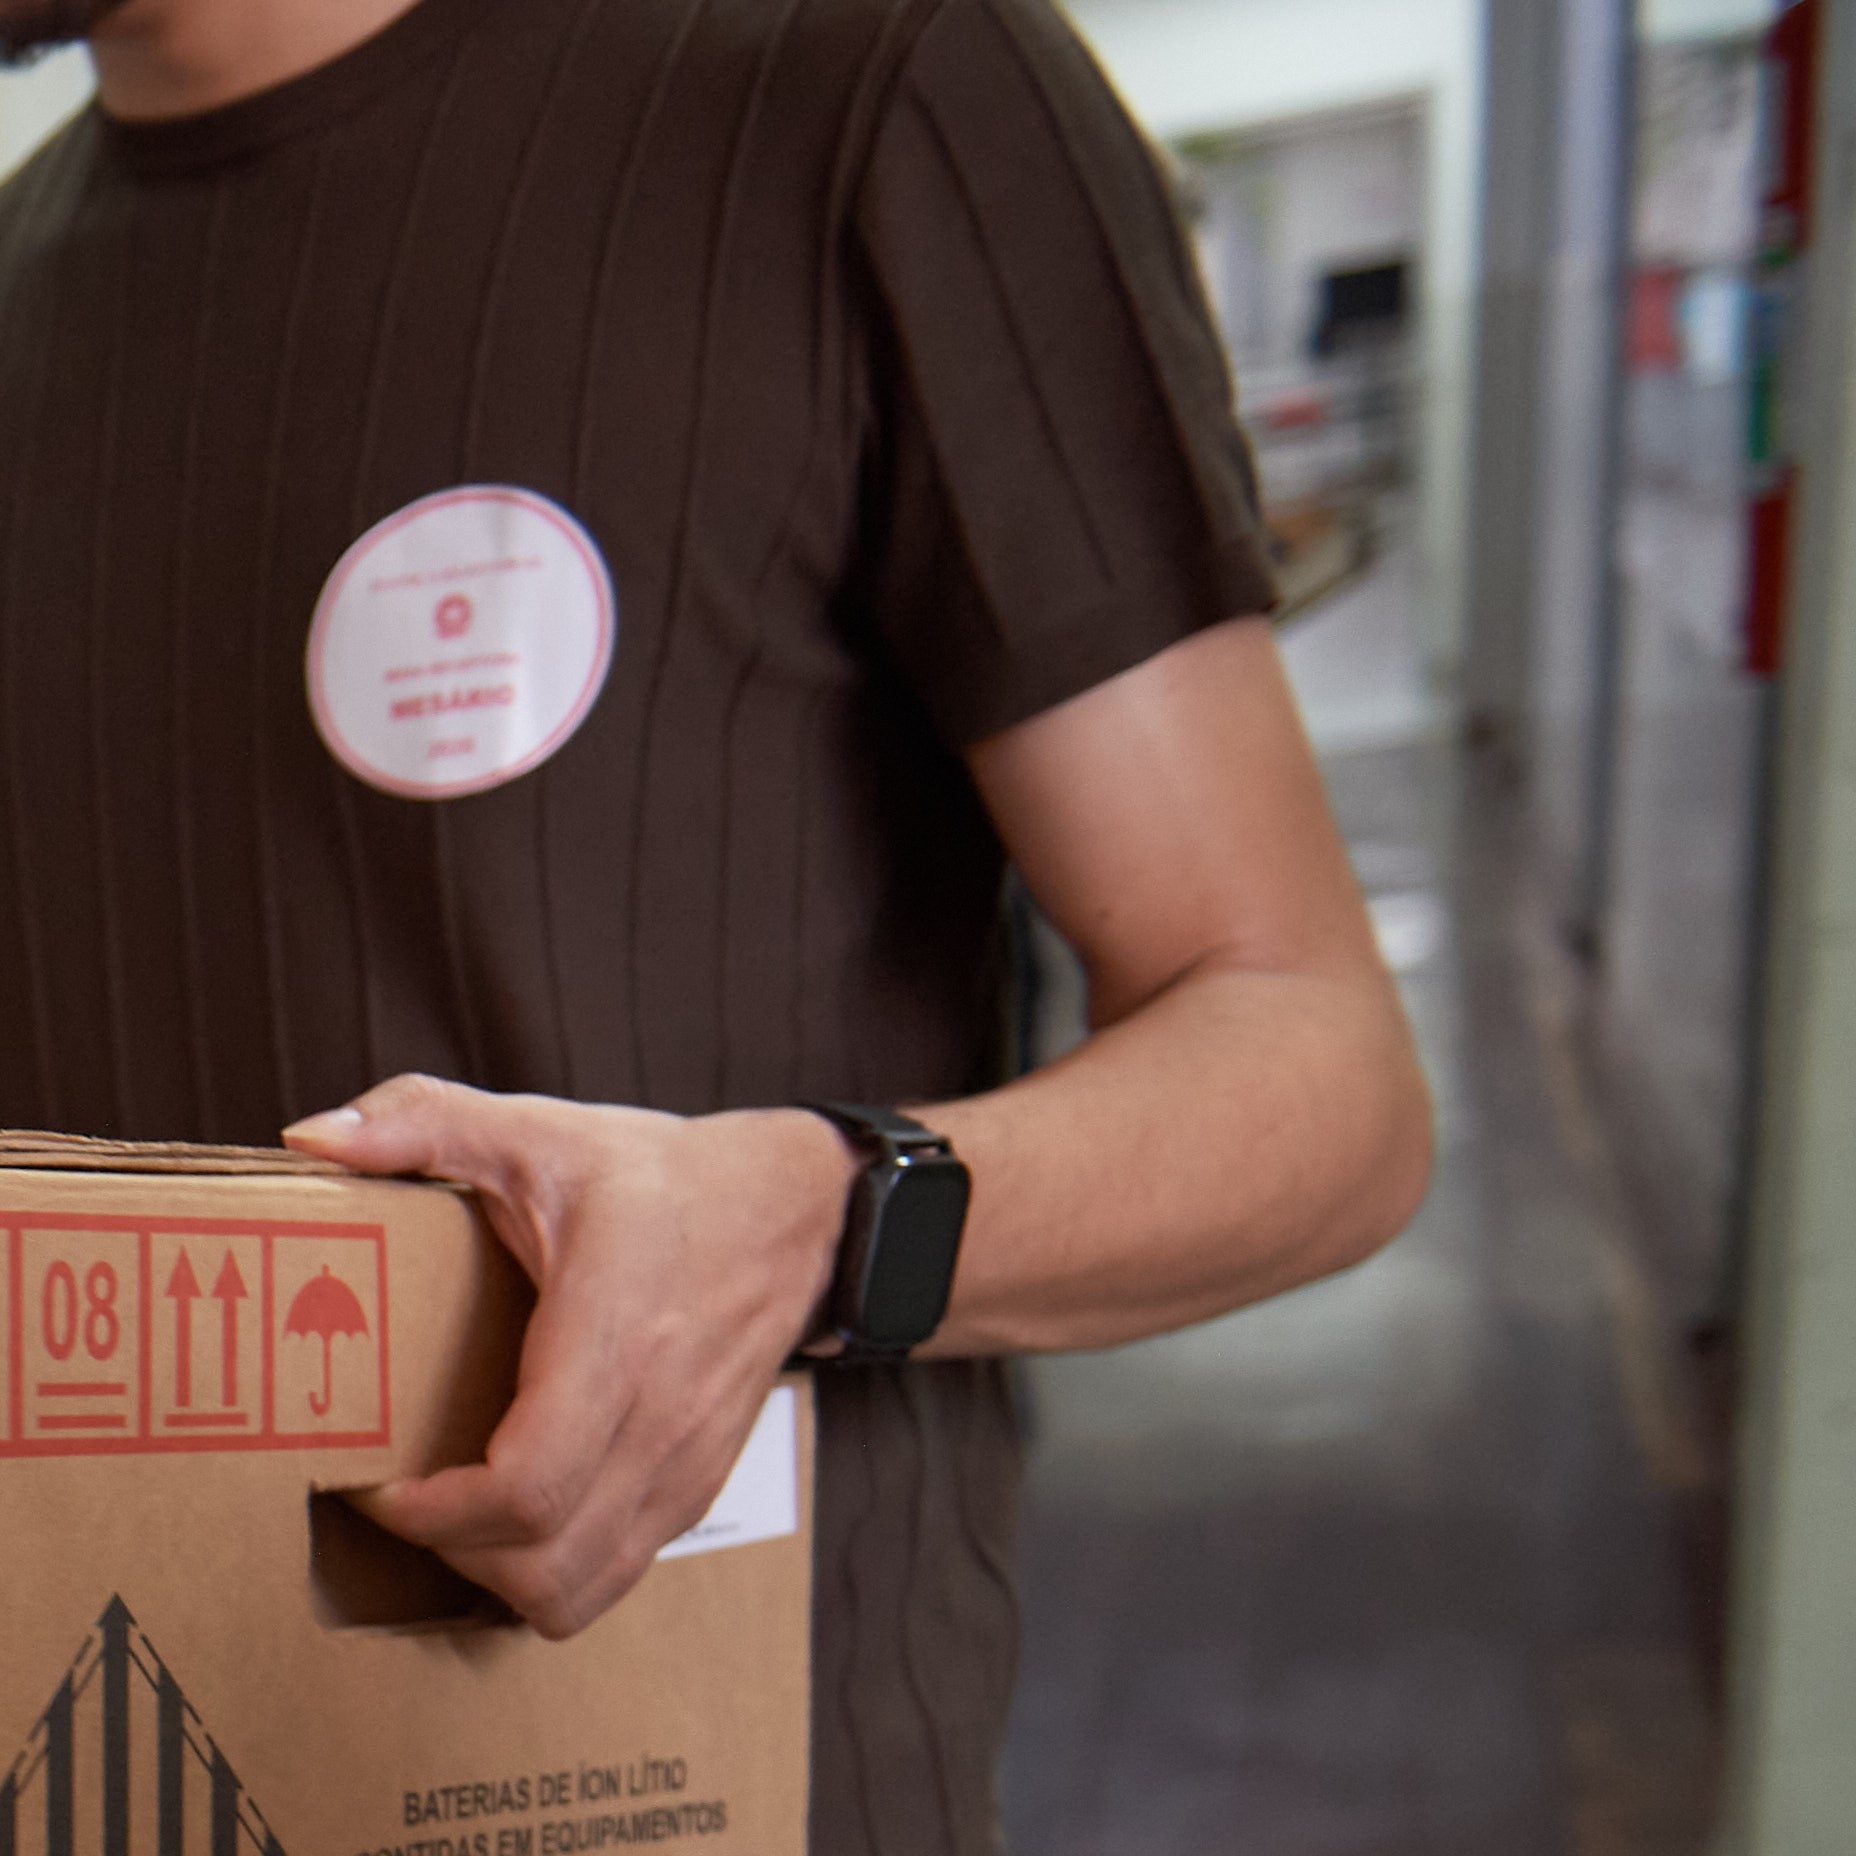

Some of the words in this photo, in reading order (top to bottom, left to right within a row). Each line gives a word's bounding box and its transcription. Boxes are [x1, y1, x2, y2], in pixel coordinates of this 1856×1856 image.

[41, 1259, 120, 1361] 08
[403, 1777, 531, 1827] BATERIAS
[539, 1771, 571, 1808] DE
[628, 1751, 687, 1797] LÍTIO
[541, 1800, 728, 1856] EQUIPAMENTOS
